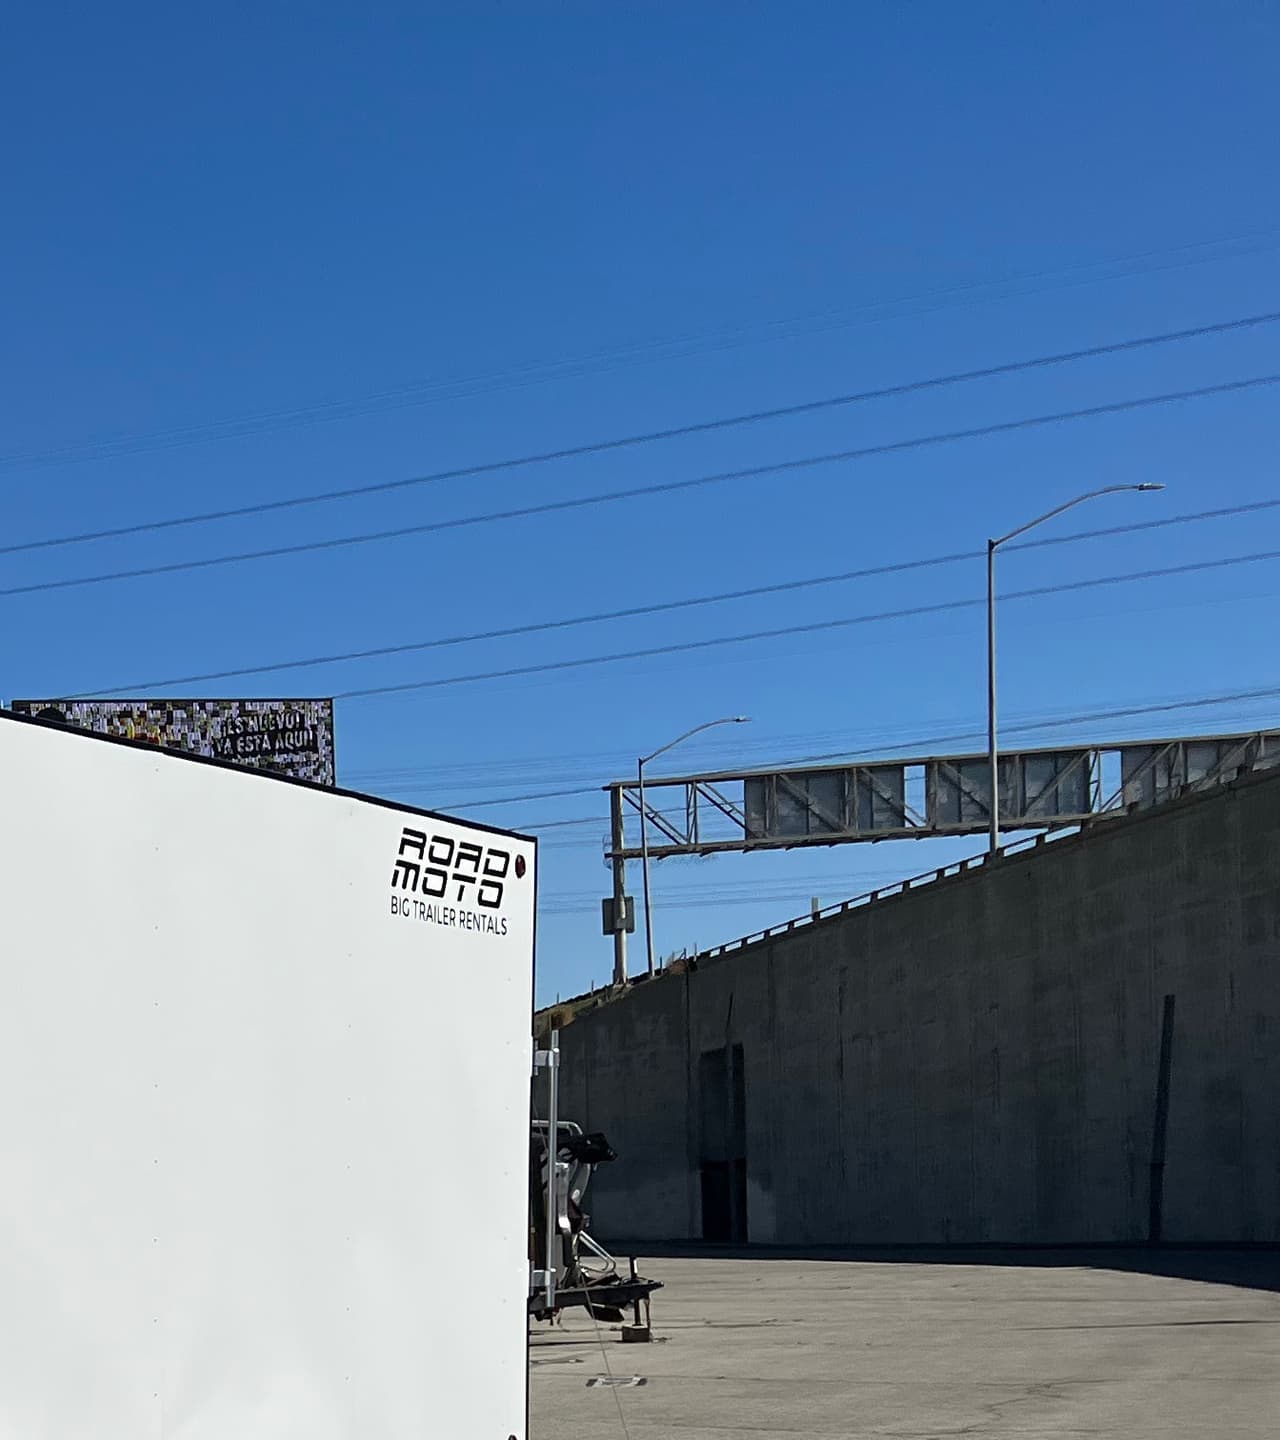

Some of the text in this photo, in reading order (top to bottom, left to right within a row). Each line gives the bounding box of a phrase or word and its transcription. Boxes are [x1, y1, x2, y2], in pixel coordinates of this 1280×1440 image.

[398, 827, 510, 878] ROAD
[391, 859, 503, 909] MOTO
[391, 896, 507, 936] BIG TRAILER RENTALS
